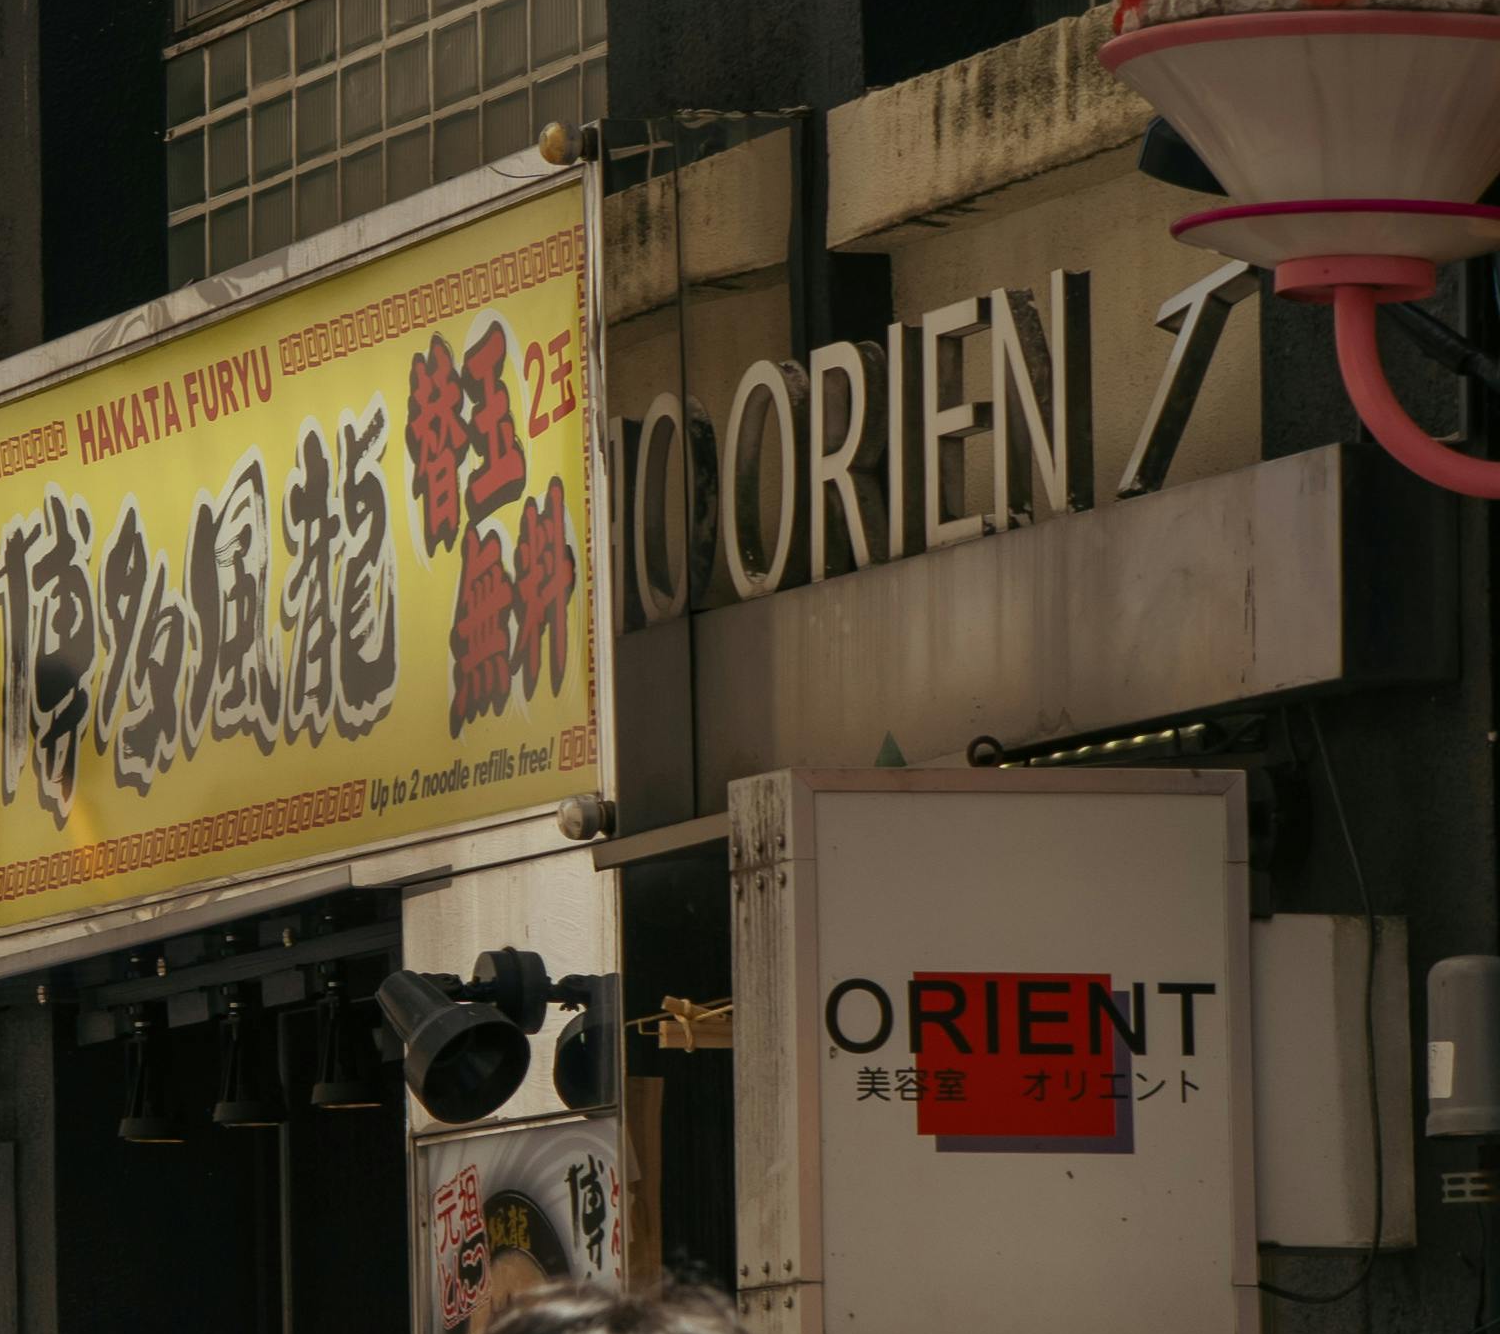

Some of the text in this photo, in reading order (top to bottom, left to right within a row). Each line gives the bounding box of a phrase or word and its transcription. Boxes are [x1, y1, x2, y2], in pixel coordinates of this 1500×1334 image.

[77, 347, 274, 466] HAKATA FURYU
[406, 317, 528, 557] 替玉
[450, 477, 576, 740] 無料
[371, 739, 555, 815] Up to 2 noodle refills free!
[824, 977, 1217, 1057] ORIENT
[856, 1066, 1200, 1104] 美容室 オリエント
[437, 1172, 483, 1255] 元祖
